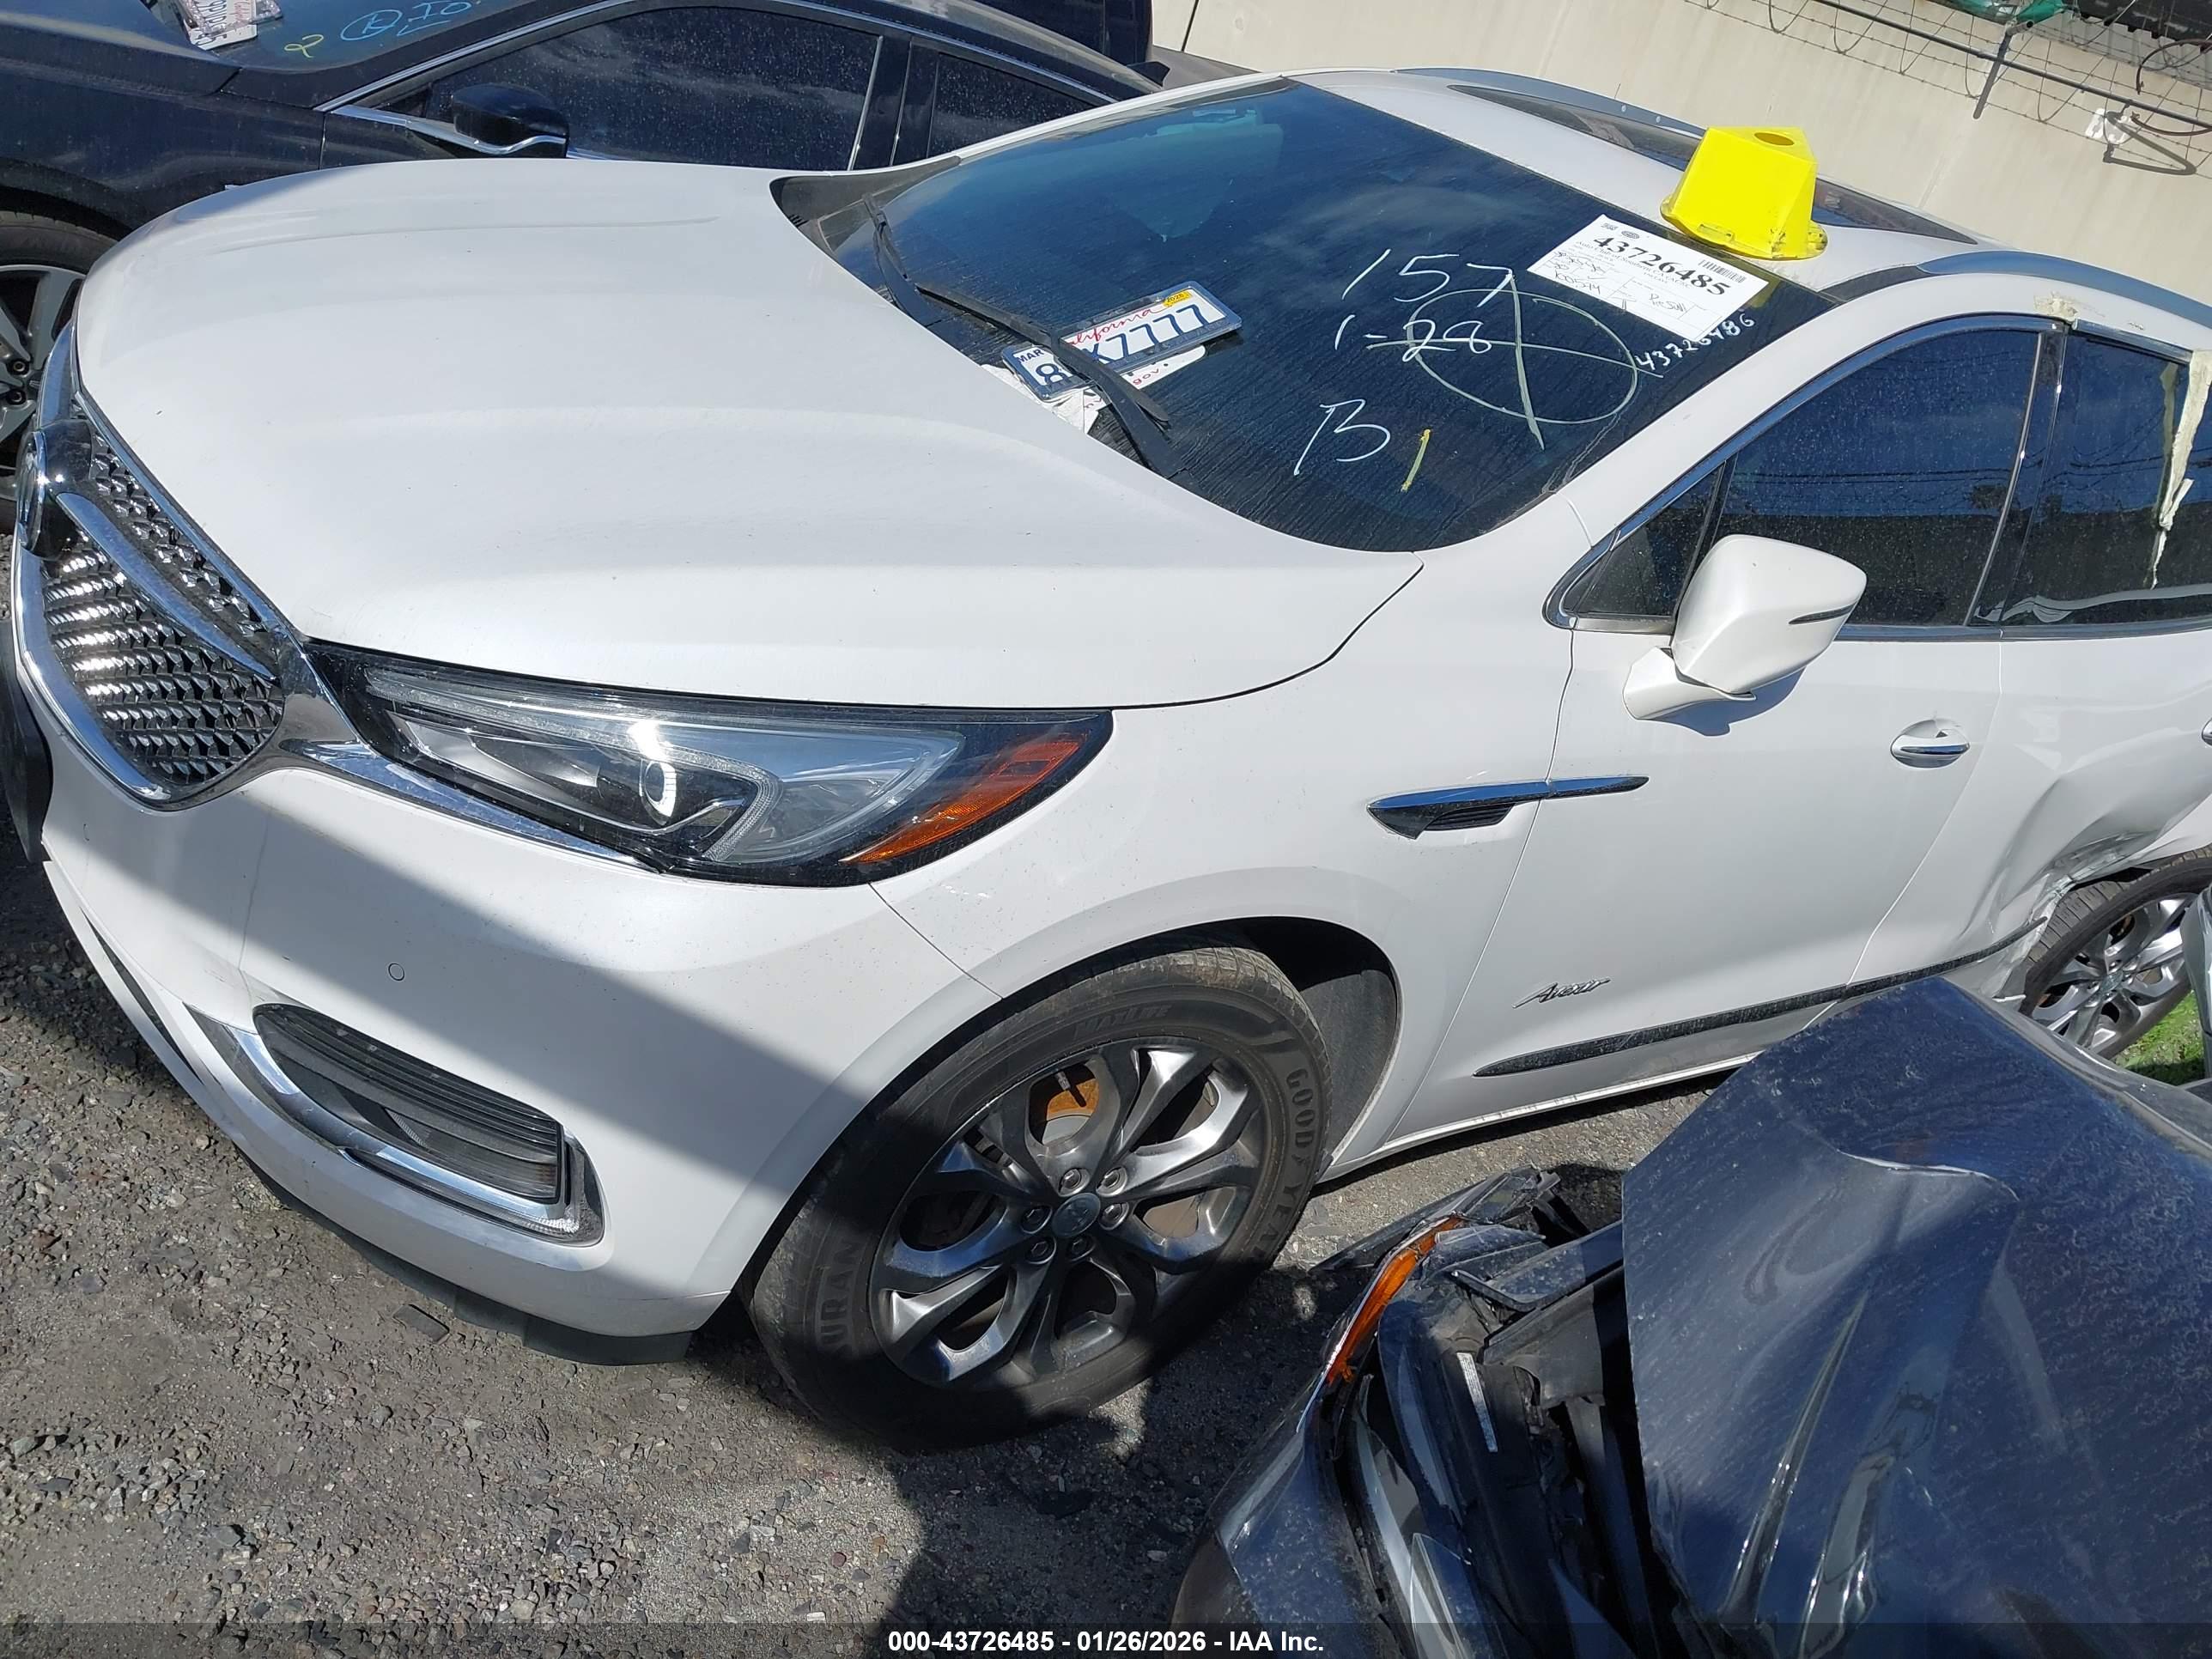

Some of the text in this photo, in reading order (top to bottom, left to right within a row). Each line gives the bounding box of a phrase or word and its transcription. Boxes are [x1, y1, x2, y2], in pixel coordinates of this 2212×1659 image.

[1342, 249, 1514, 307] 157
[1593, 237, 1732, 295] 43726485
[1071, 307, 1165, 344] lifornia
[1017, 349, 1045, 364] MAR
[1133, 368, 1160, 386] gov
